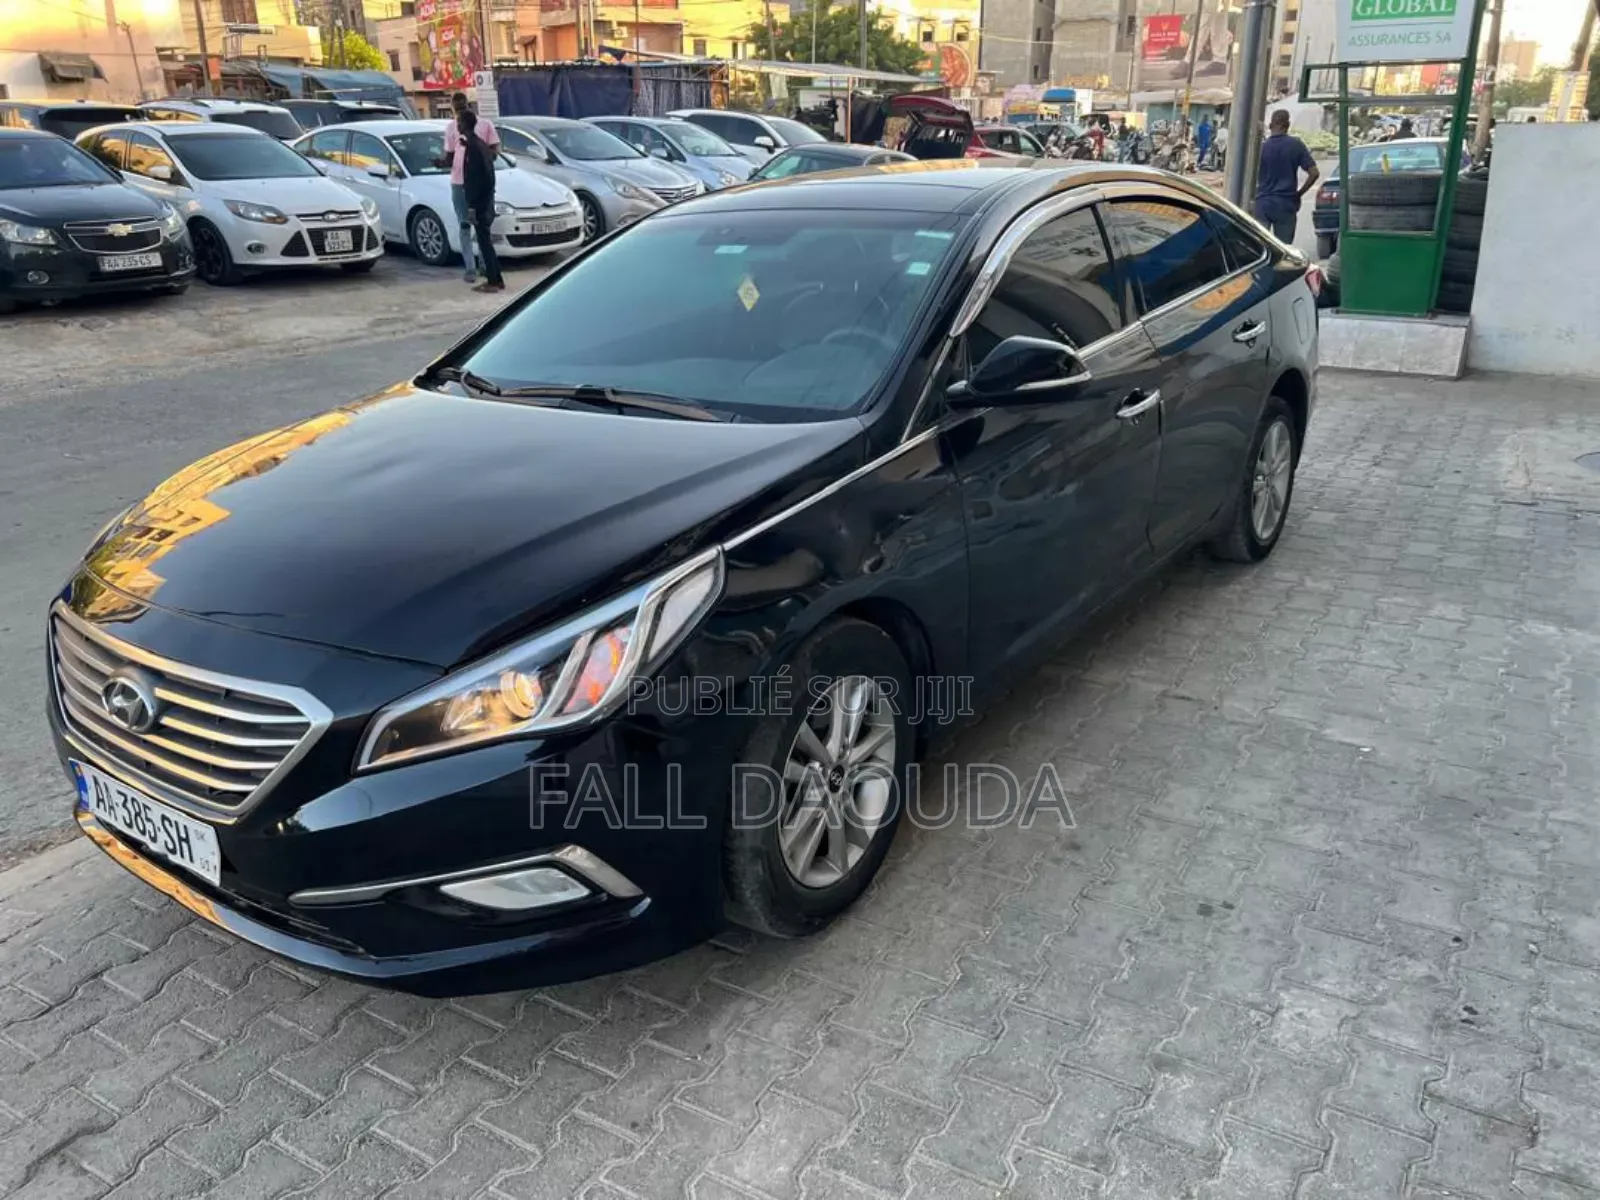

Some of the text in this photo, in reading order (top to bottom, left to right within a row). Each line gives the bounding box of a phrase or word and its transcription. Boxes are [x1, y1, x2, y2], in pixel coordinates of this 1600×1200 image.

[1355, 0, 1453, 16] GLOBAL
[1348, 31, 1452, 47] ASSURANCES SA
